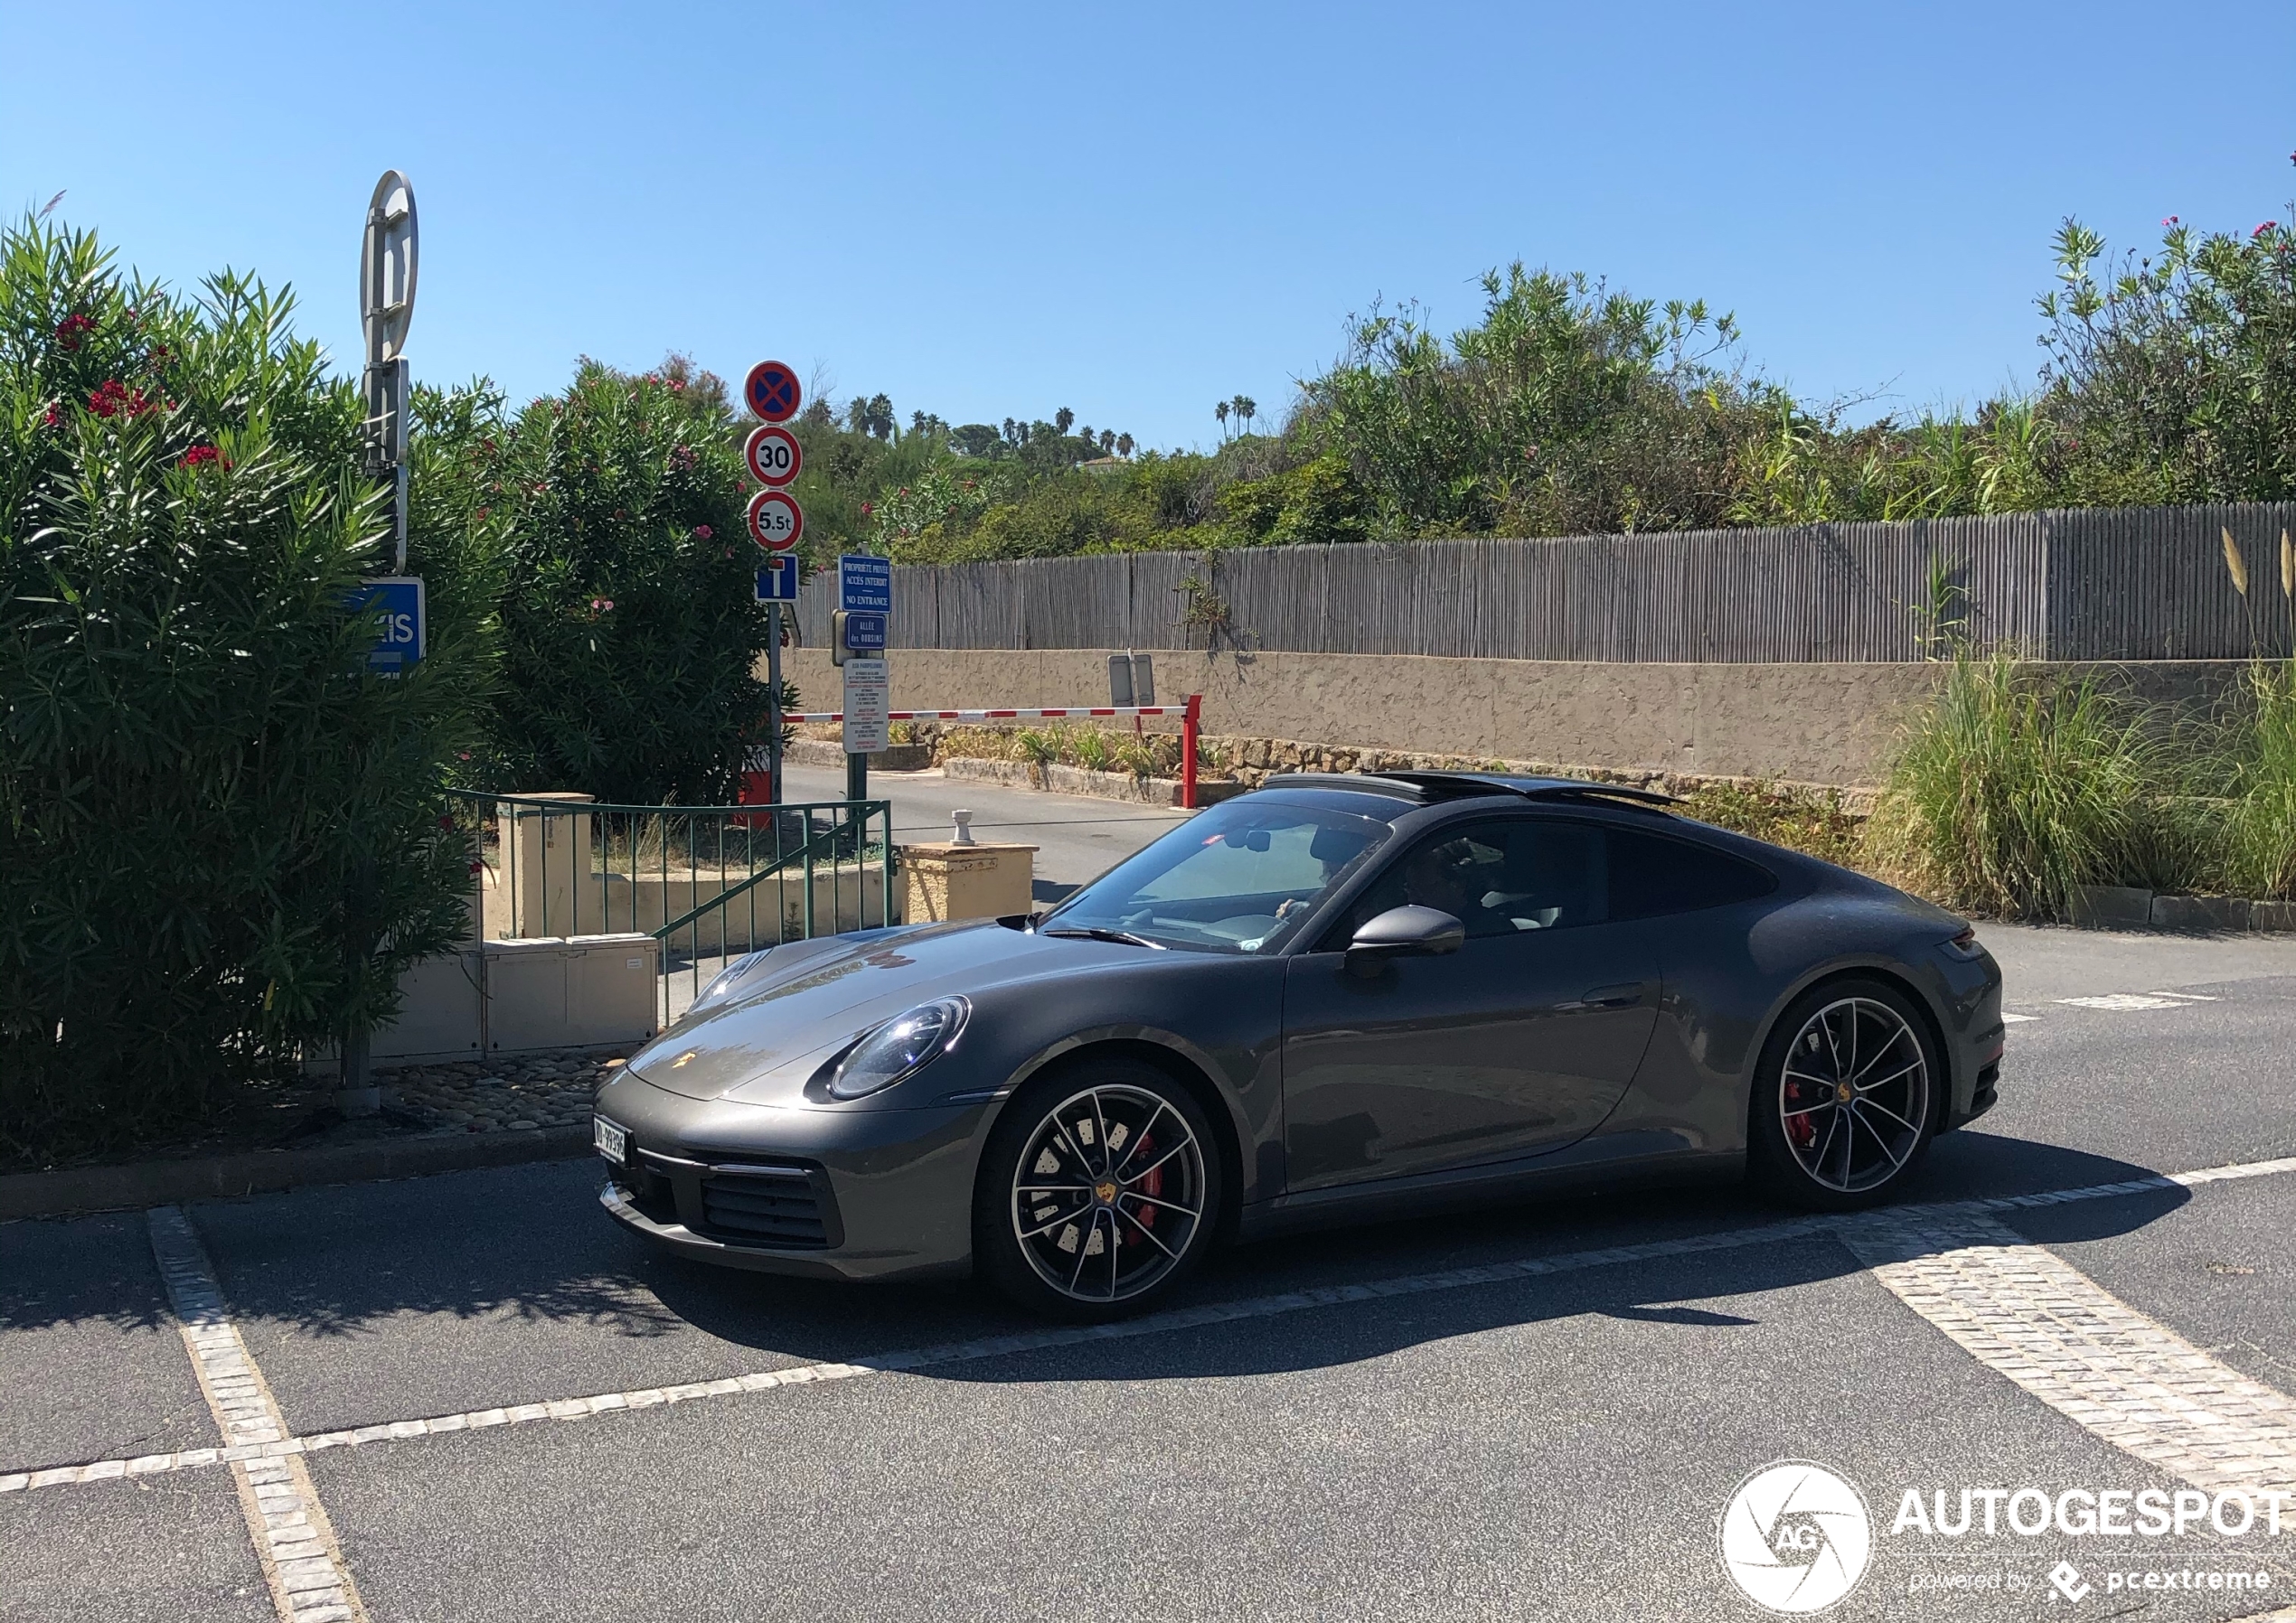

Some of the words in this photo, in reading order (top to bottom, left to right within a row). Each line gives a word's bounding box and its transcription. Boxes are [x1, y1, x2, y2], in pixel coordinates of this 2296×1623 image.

[759, 446, 790, 469] 30
[758, 512, 792, 530] 5.5t
[843, 561, 872, 573] PROPRIÉTÉ
[872, 563, 889, 575] PRIVÉE
[846, 574, 864, 586] ACCÈS
[864, 577, 888, 587] INTERDIT
[846, 595, 856, 605] NO
[857, 596, 889, 606] ENTRANCE
[860, 620, 875, 631] ALLÉE
